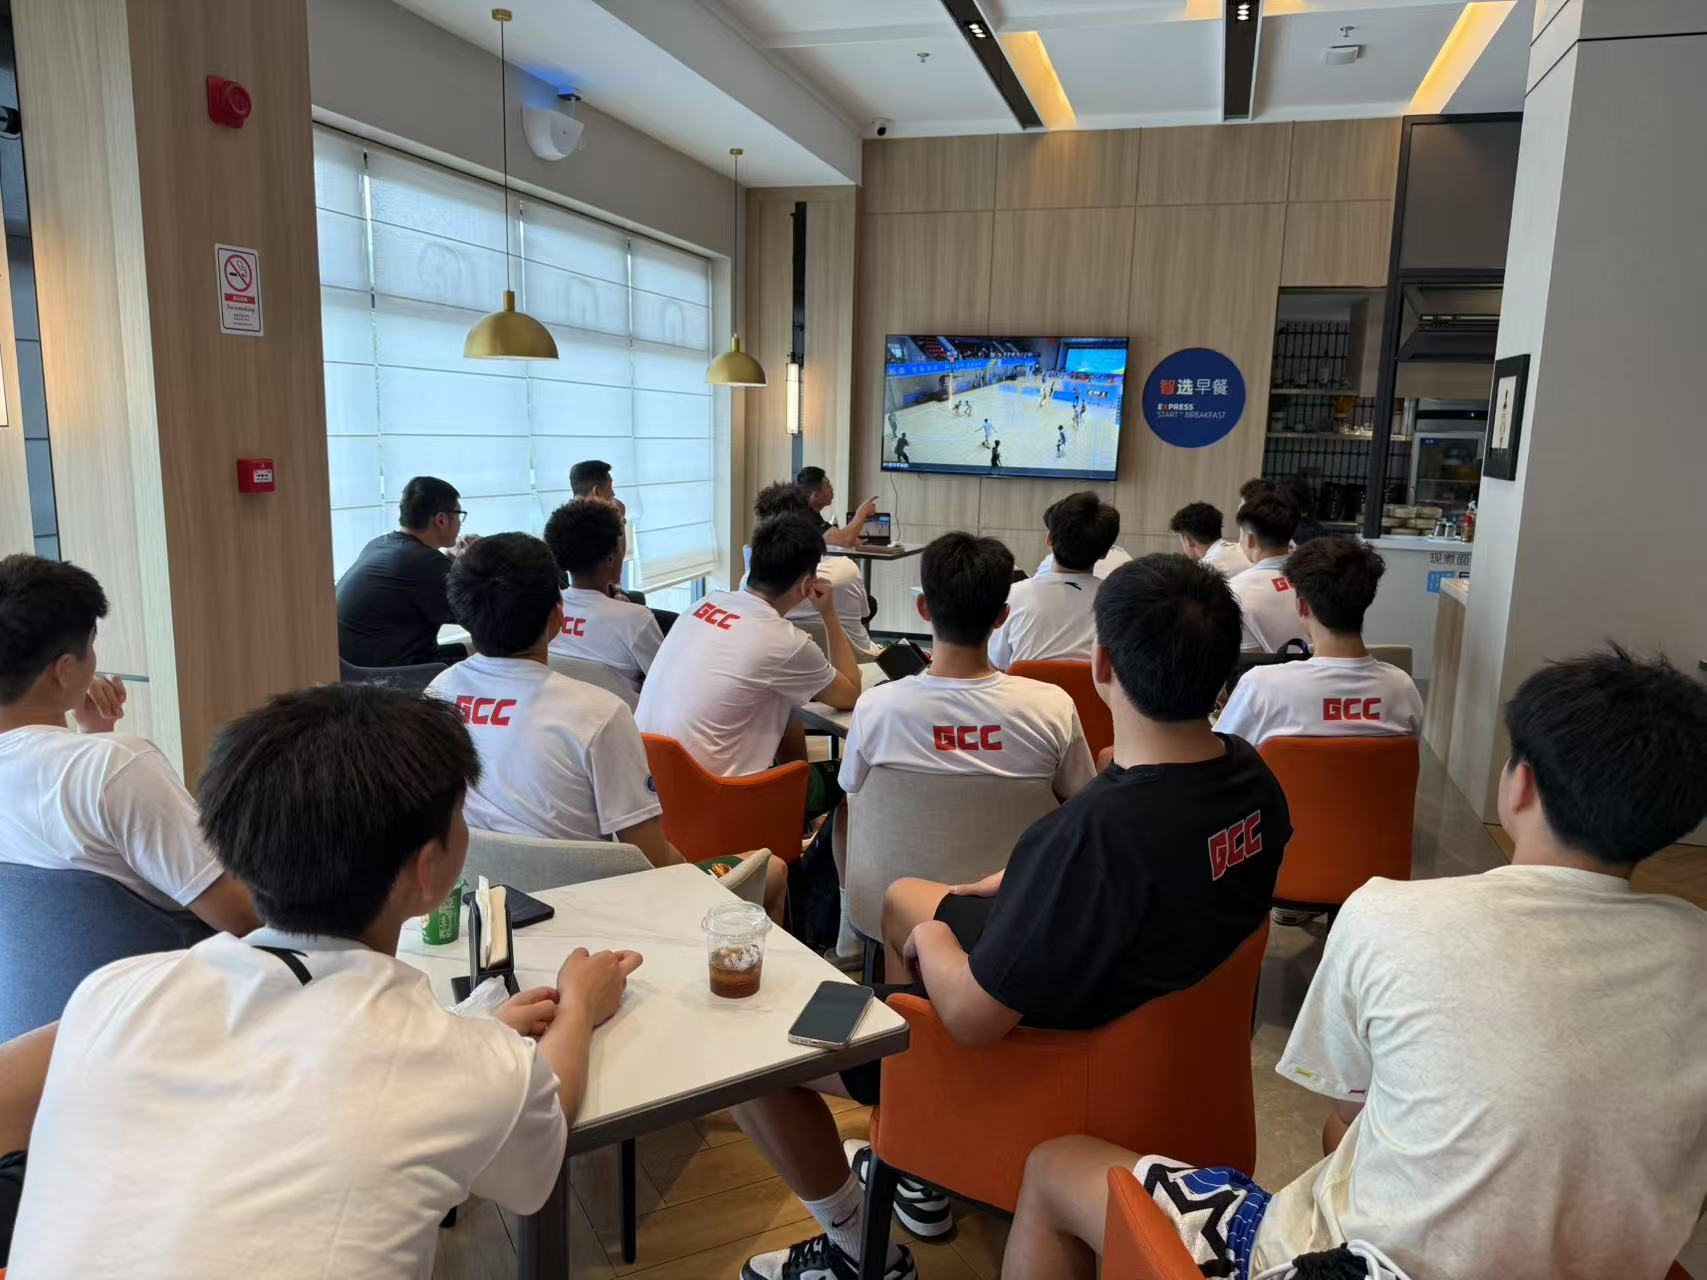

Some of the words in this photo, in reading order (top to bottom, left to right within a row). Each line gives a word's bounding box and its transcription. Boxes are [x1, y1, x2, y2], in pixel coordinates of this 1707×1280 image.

[1160, 378, 1228, 396] 智选早餐
[1157, 403, 1194, 411] EXPRESS
[1184, 411, 1226, 419] BREAKFAST
[693, 602, 741, 630] GCC
[1323, 698, 1381, 721] GCC
[933, 725, 1003, 751] GCC
[1208, 809, 1262, 881] GCC
